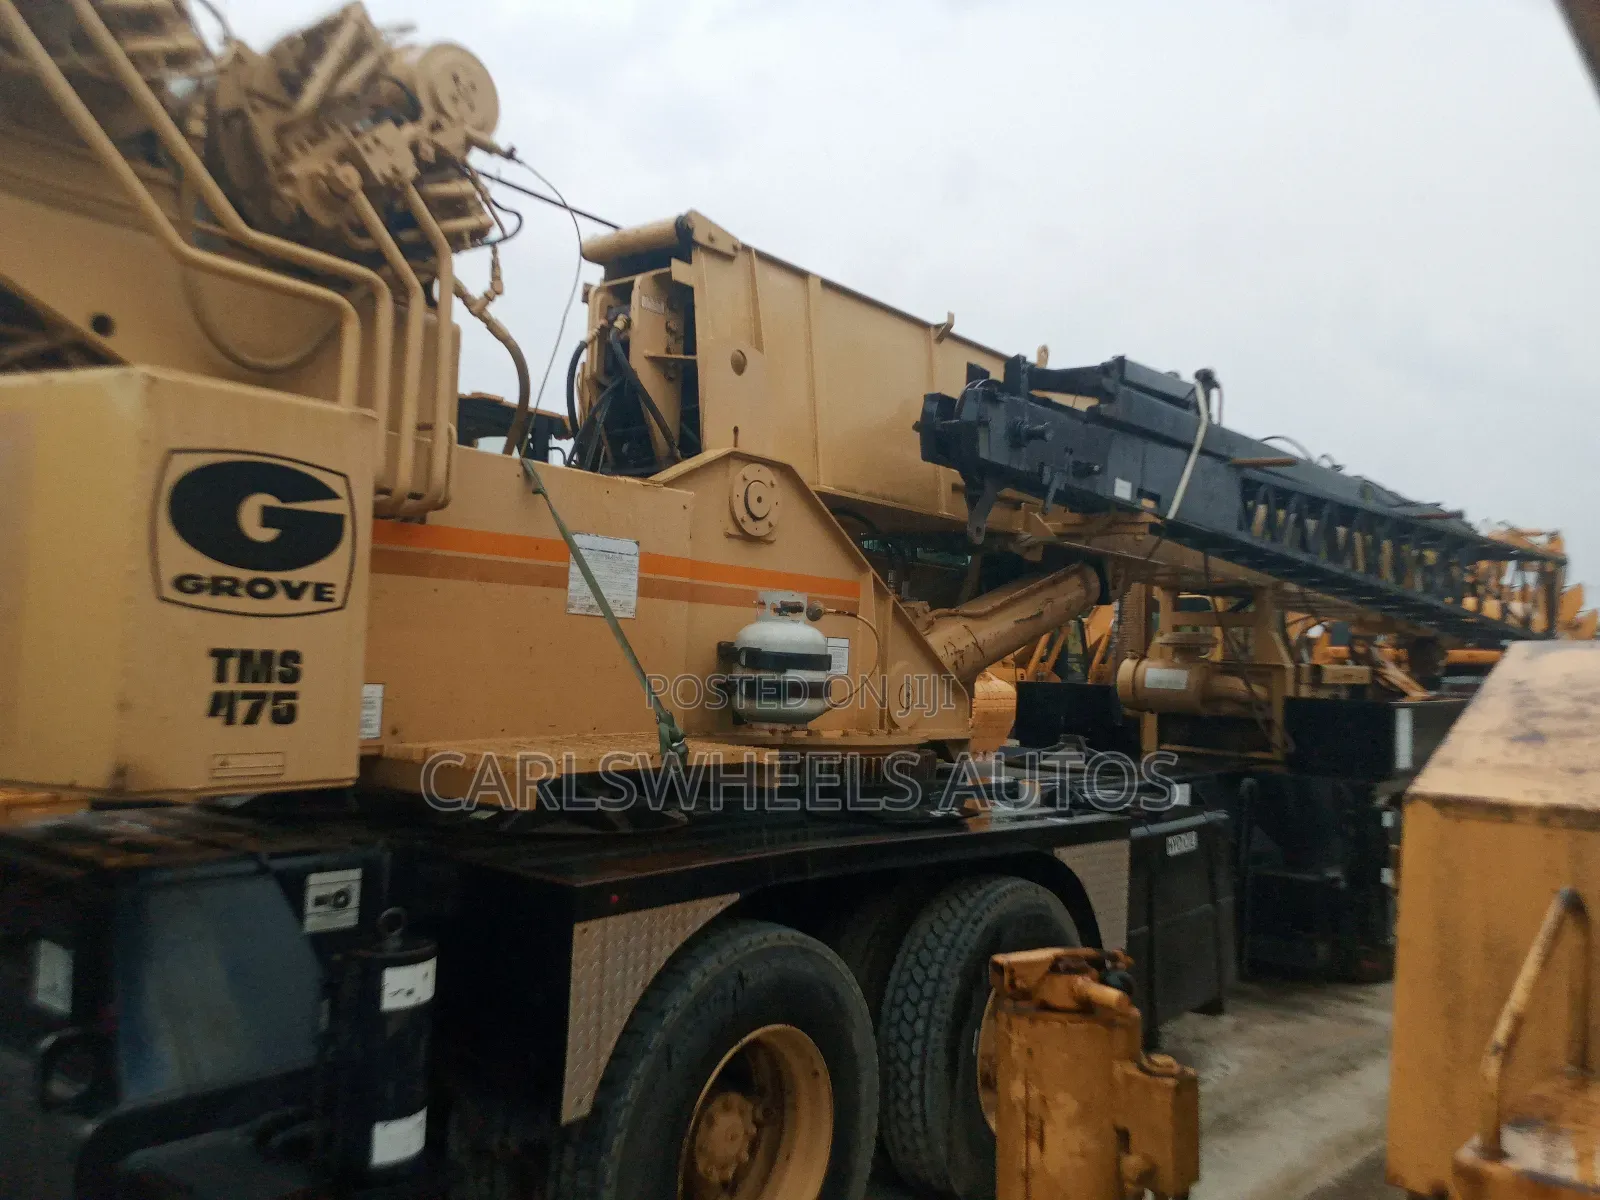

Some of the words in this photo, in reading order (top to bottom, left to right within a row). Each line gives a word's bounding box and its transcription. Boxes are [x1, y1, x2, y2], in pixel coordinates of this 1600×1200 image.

[169, 460, 346, 573] G
[172, 573, 336, 603] GROVE
[208, 648, 304, 684] TMS
[207, 690, 299, 726] 475
